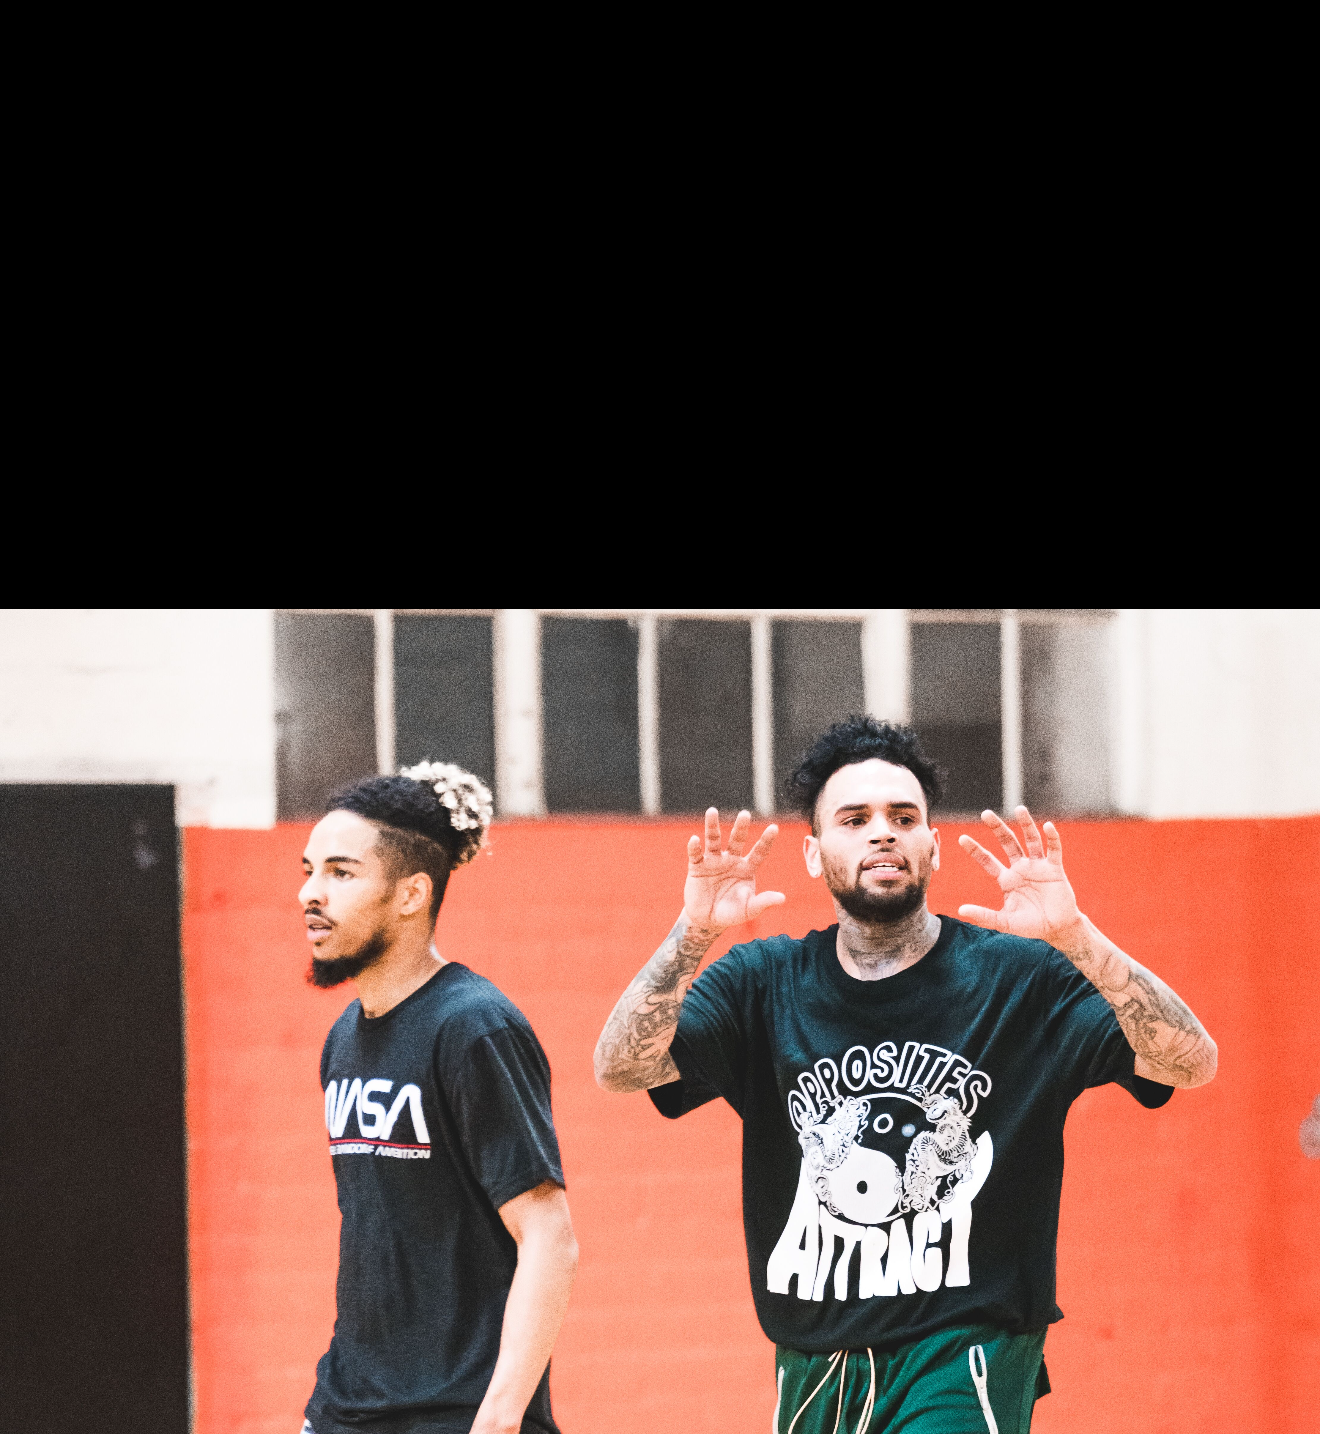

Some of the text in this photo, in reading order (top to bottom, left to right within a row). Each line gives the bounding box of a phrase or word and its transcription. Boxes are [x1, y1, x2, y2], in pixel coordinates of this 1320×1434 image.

[324, 1077, 431, 1144] NASA
[787, 1041, 992, 1133] OPPOSITES
[374, 1145, 431, 1159] AMBITION
[766, 1130, 994, 1301] ATTRACT
